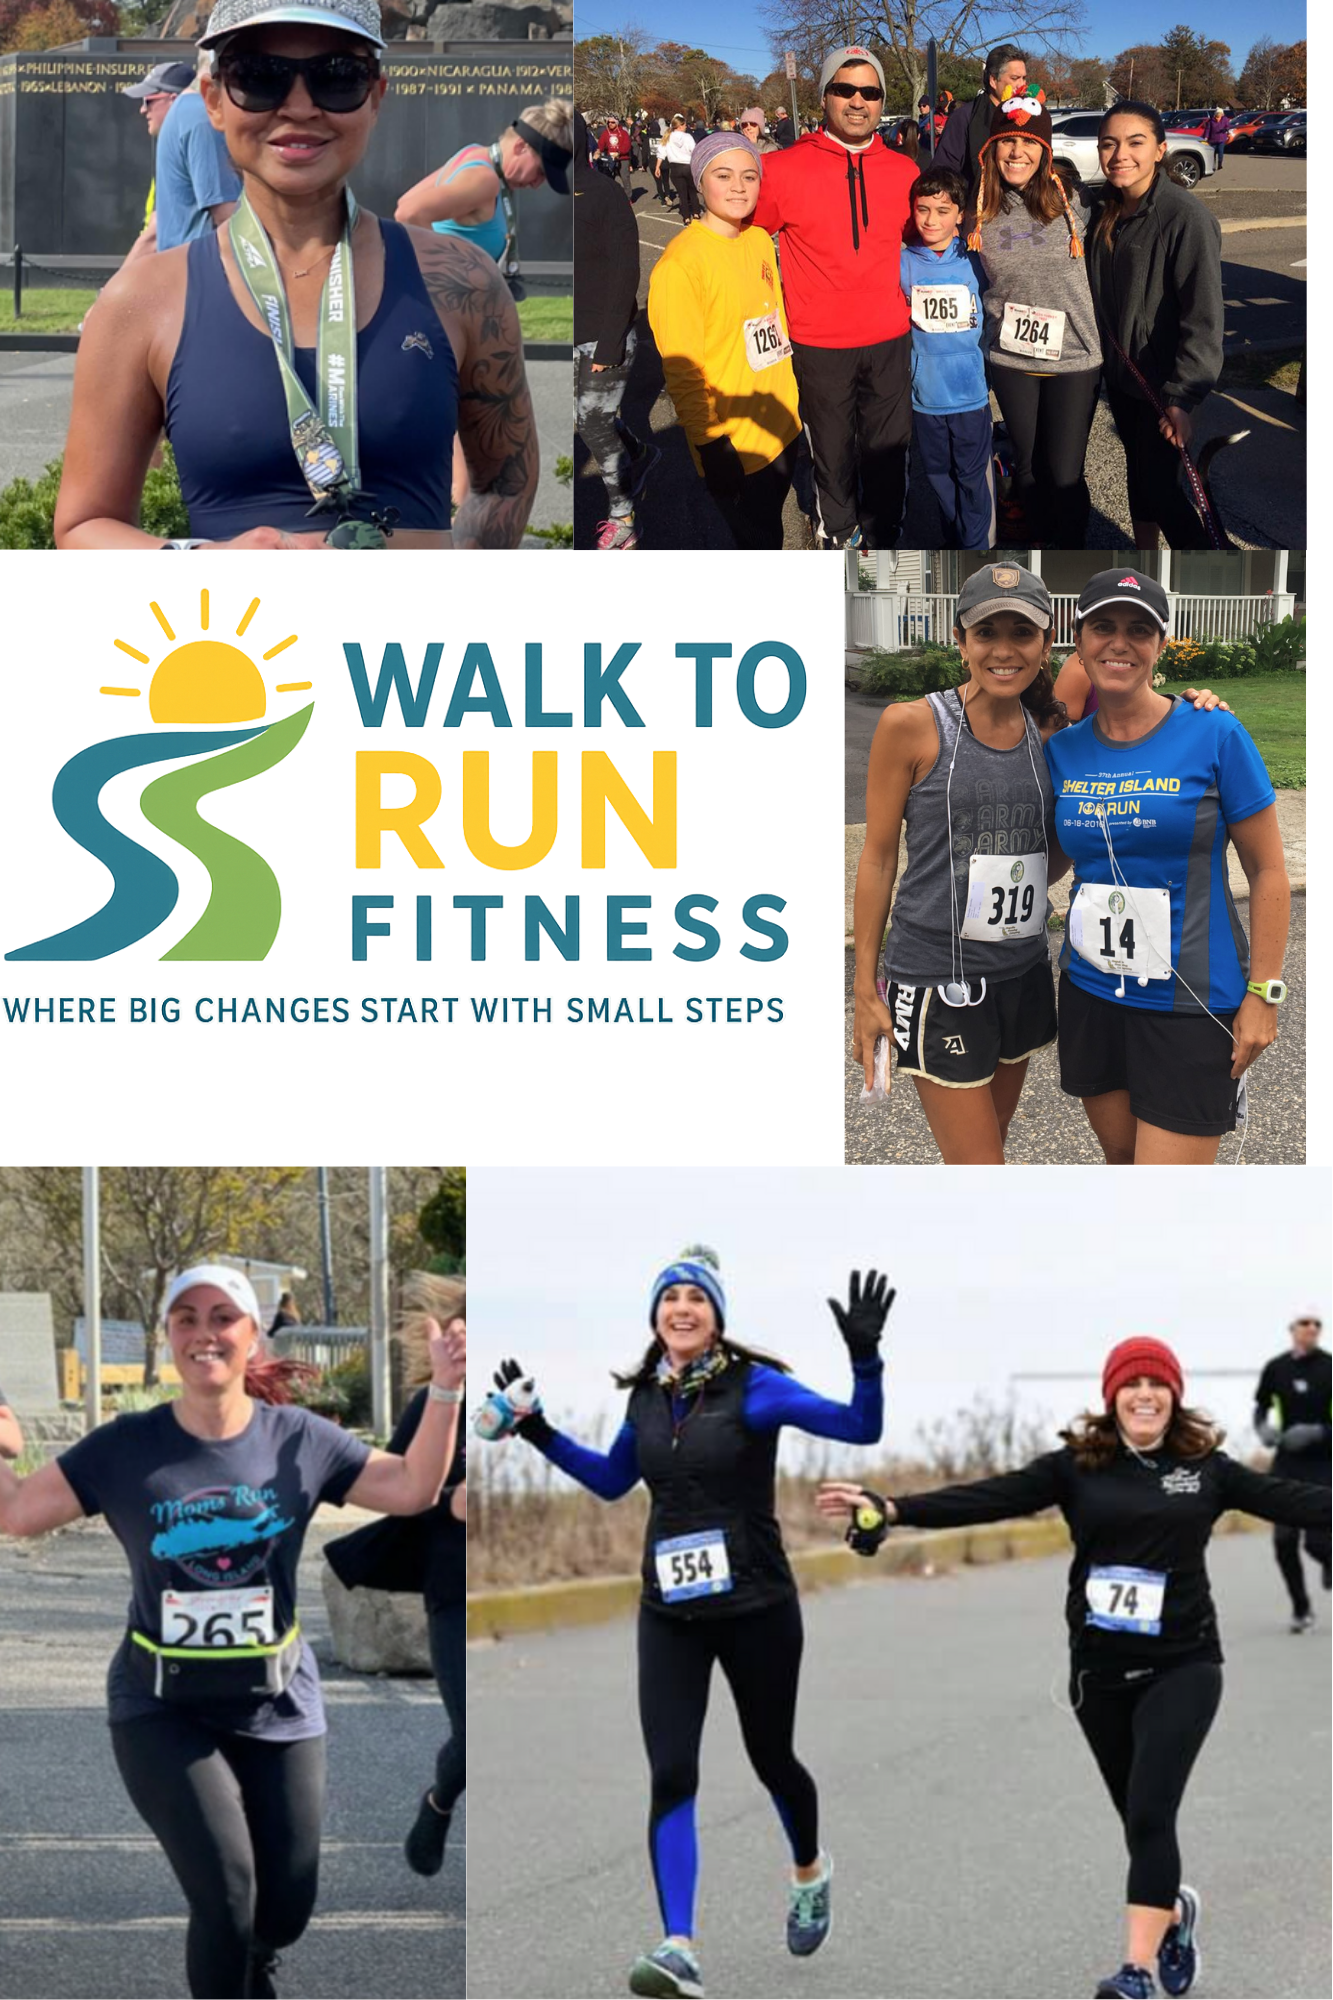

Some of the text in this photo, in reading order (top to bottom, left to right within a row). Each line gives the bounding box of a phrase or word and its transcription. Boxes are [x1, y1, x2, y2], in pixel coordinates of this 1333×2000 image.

[479, 83, 543, 95] PANAMA
[923, 297, 958, 320] 1265
[1014, 317, 1050, 345] 1264
[1117, 581, 1142, 591] adidas
[1062, 778, 1181, 795] SHELTER ISLAND
[1112, 771, 1134, 779] Annual
[1106, 800, 1140, 816] RUN
[977, 828, 1045, 855] ARMY
[987, 884, 1035, 926] 319
[1100, 917, 1135, 960] 14
[150, 1484, 278, 1524] Moms Run
[671, 1549, 713, 1586] 554
[1109, 1584, 1138, 1616] 74
[173, 1610, 267, 1647] 265
